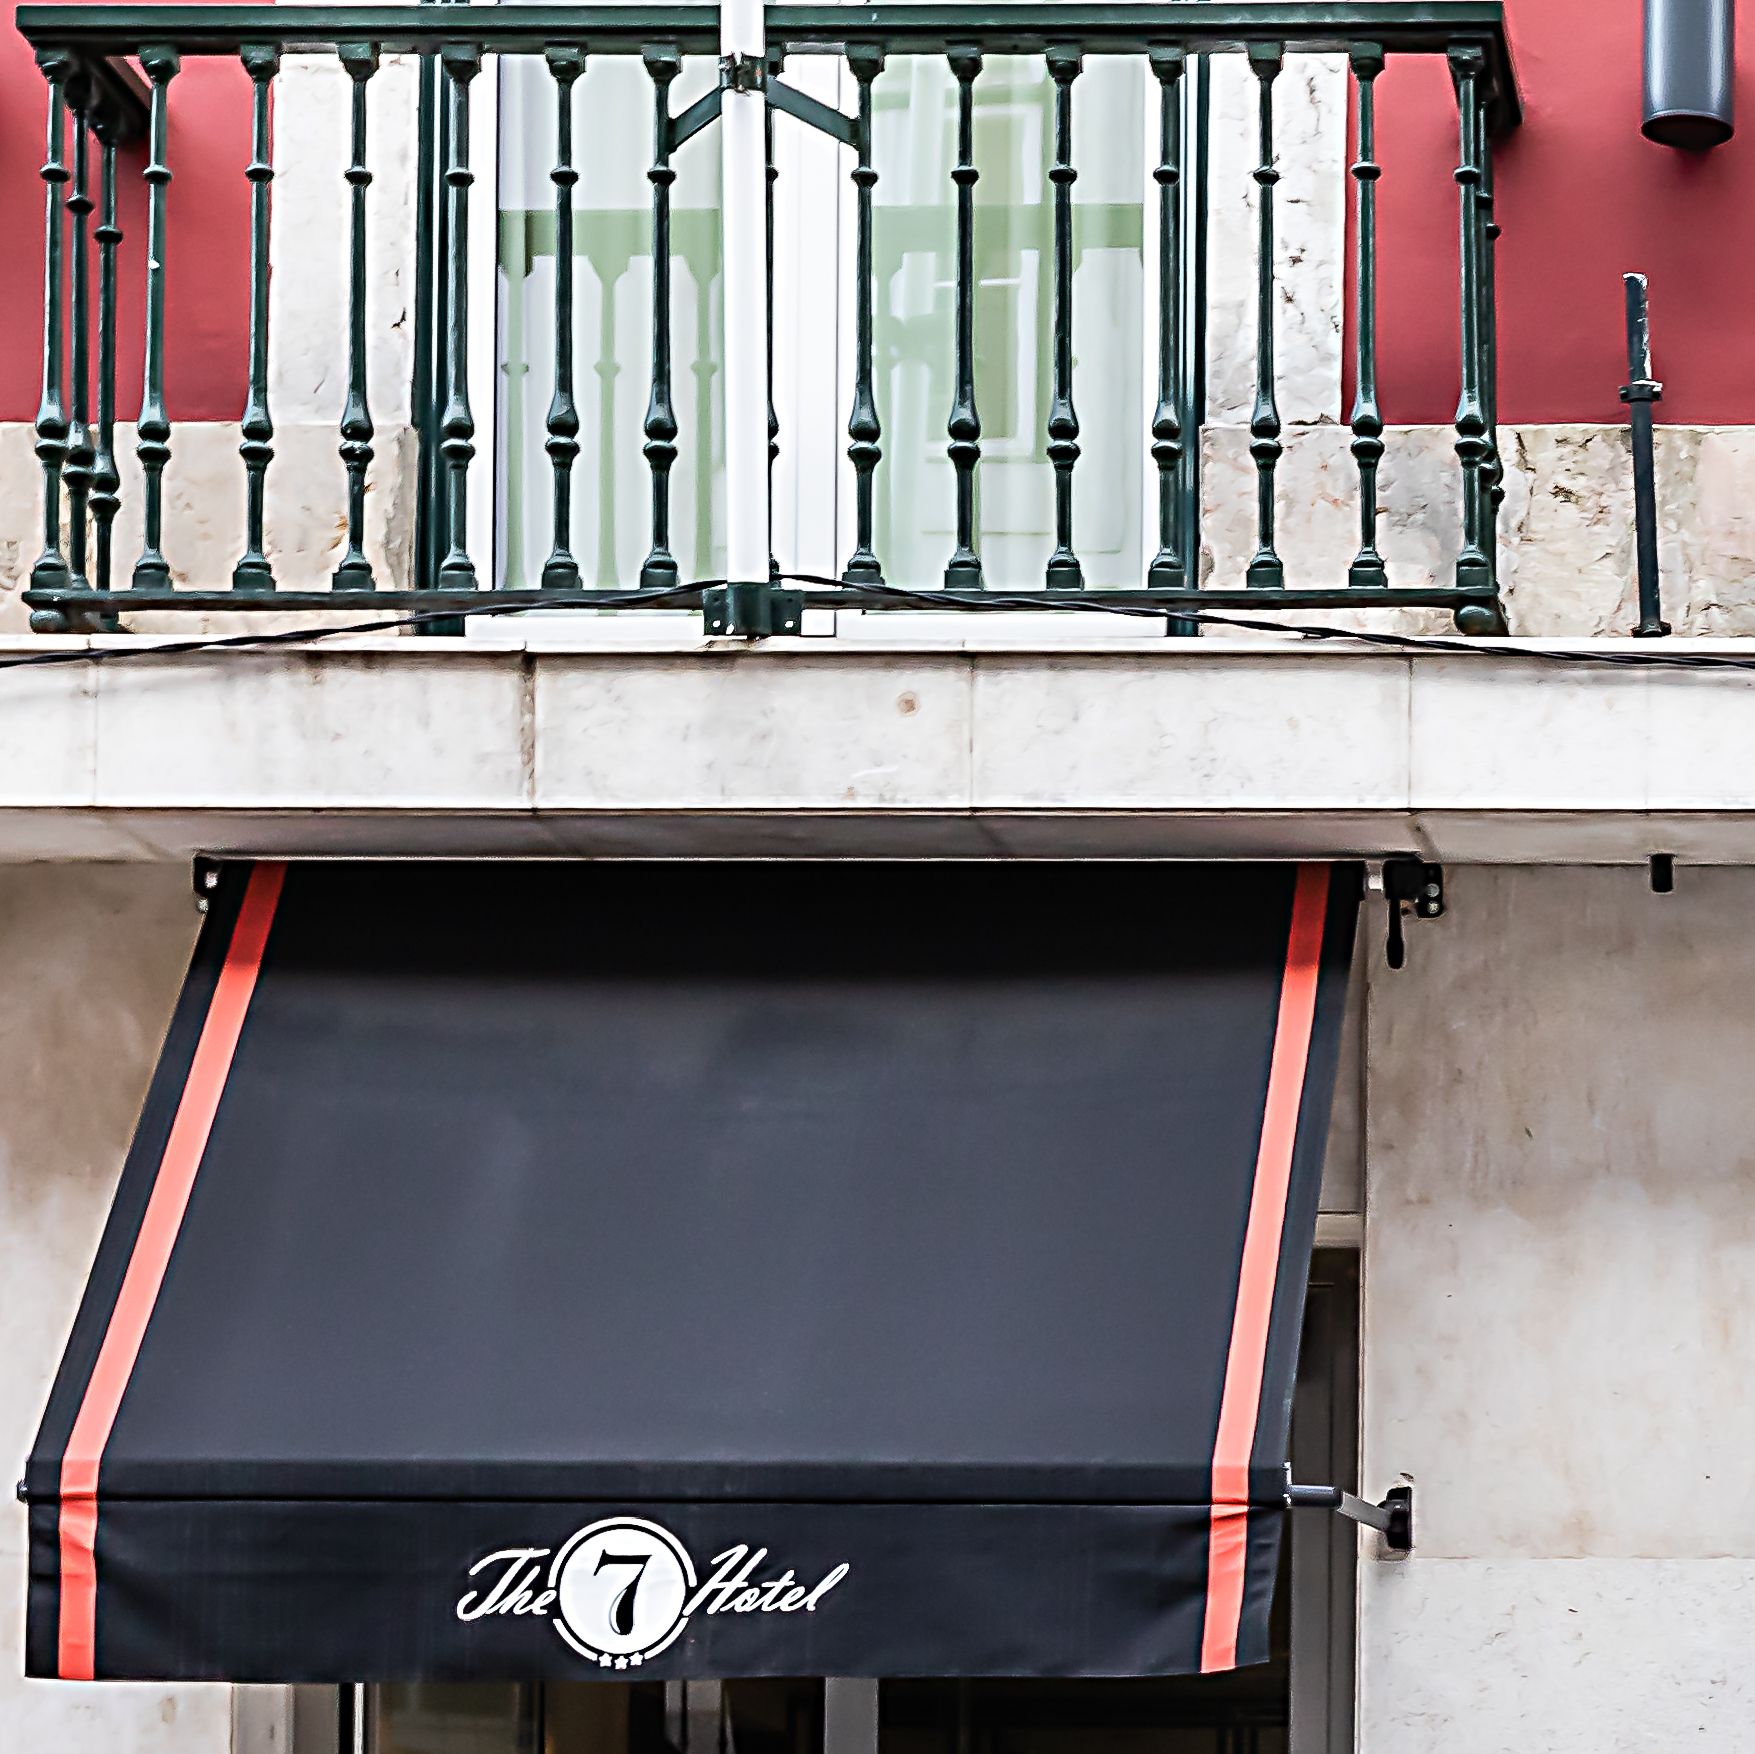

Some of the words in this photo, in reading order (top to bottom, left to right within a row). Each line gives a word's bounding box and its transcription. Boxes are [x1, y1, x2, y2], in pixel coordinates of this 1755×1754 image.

[456, 1547, 557, 1622] The
[594, 1549, 652, 1636] 7
[683, 1543, 850, 1616] Hotel
